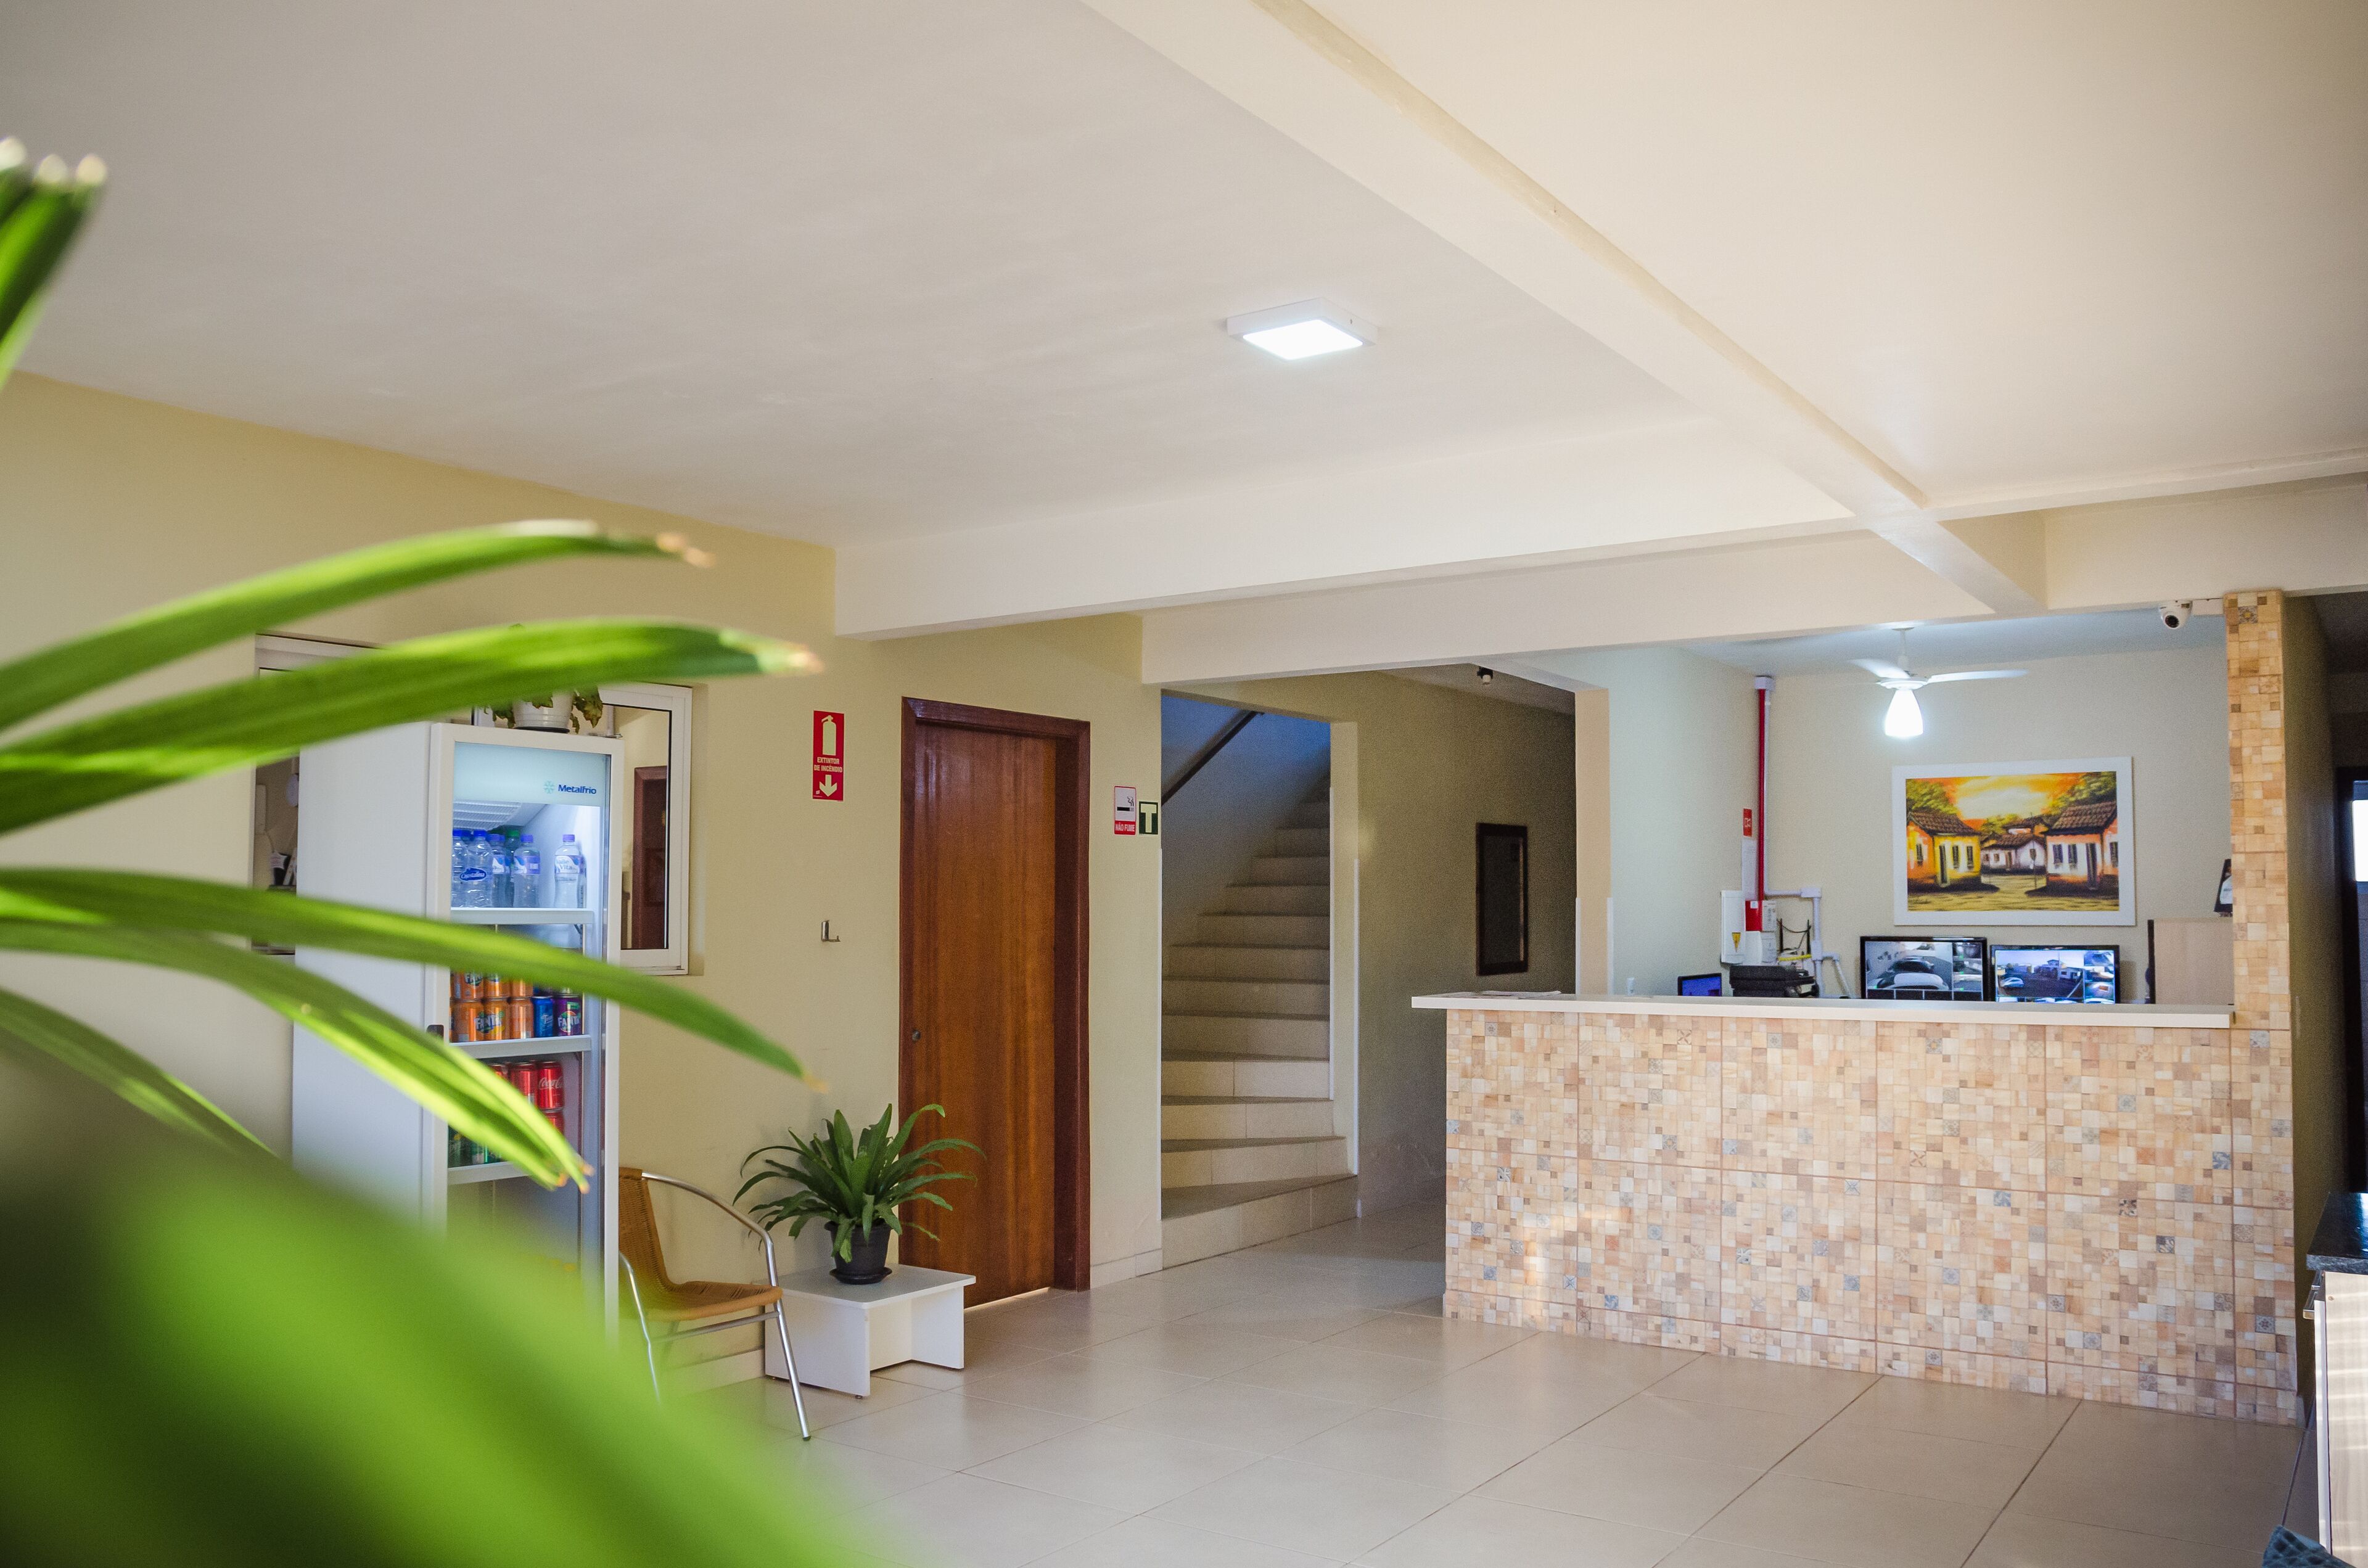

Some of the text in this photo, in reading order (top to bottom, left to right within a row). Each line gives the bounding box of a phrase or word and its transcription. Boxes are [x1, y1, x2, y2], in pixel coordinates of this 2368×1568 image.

[821, 765, 842, 773] INCÊNDIO
[558, 784, 596, 794] Metalfrio
[1115, 822, 1135, 832] NÃO FUME
